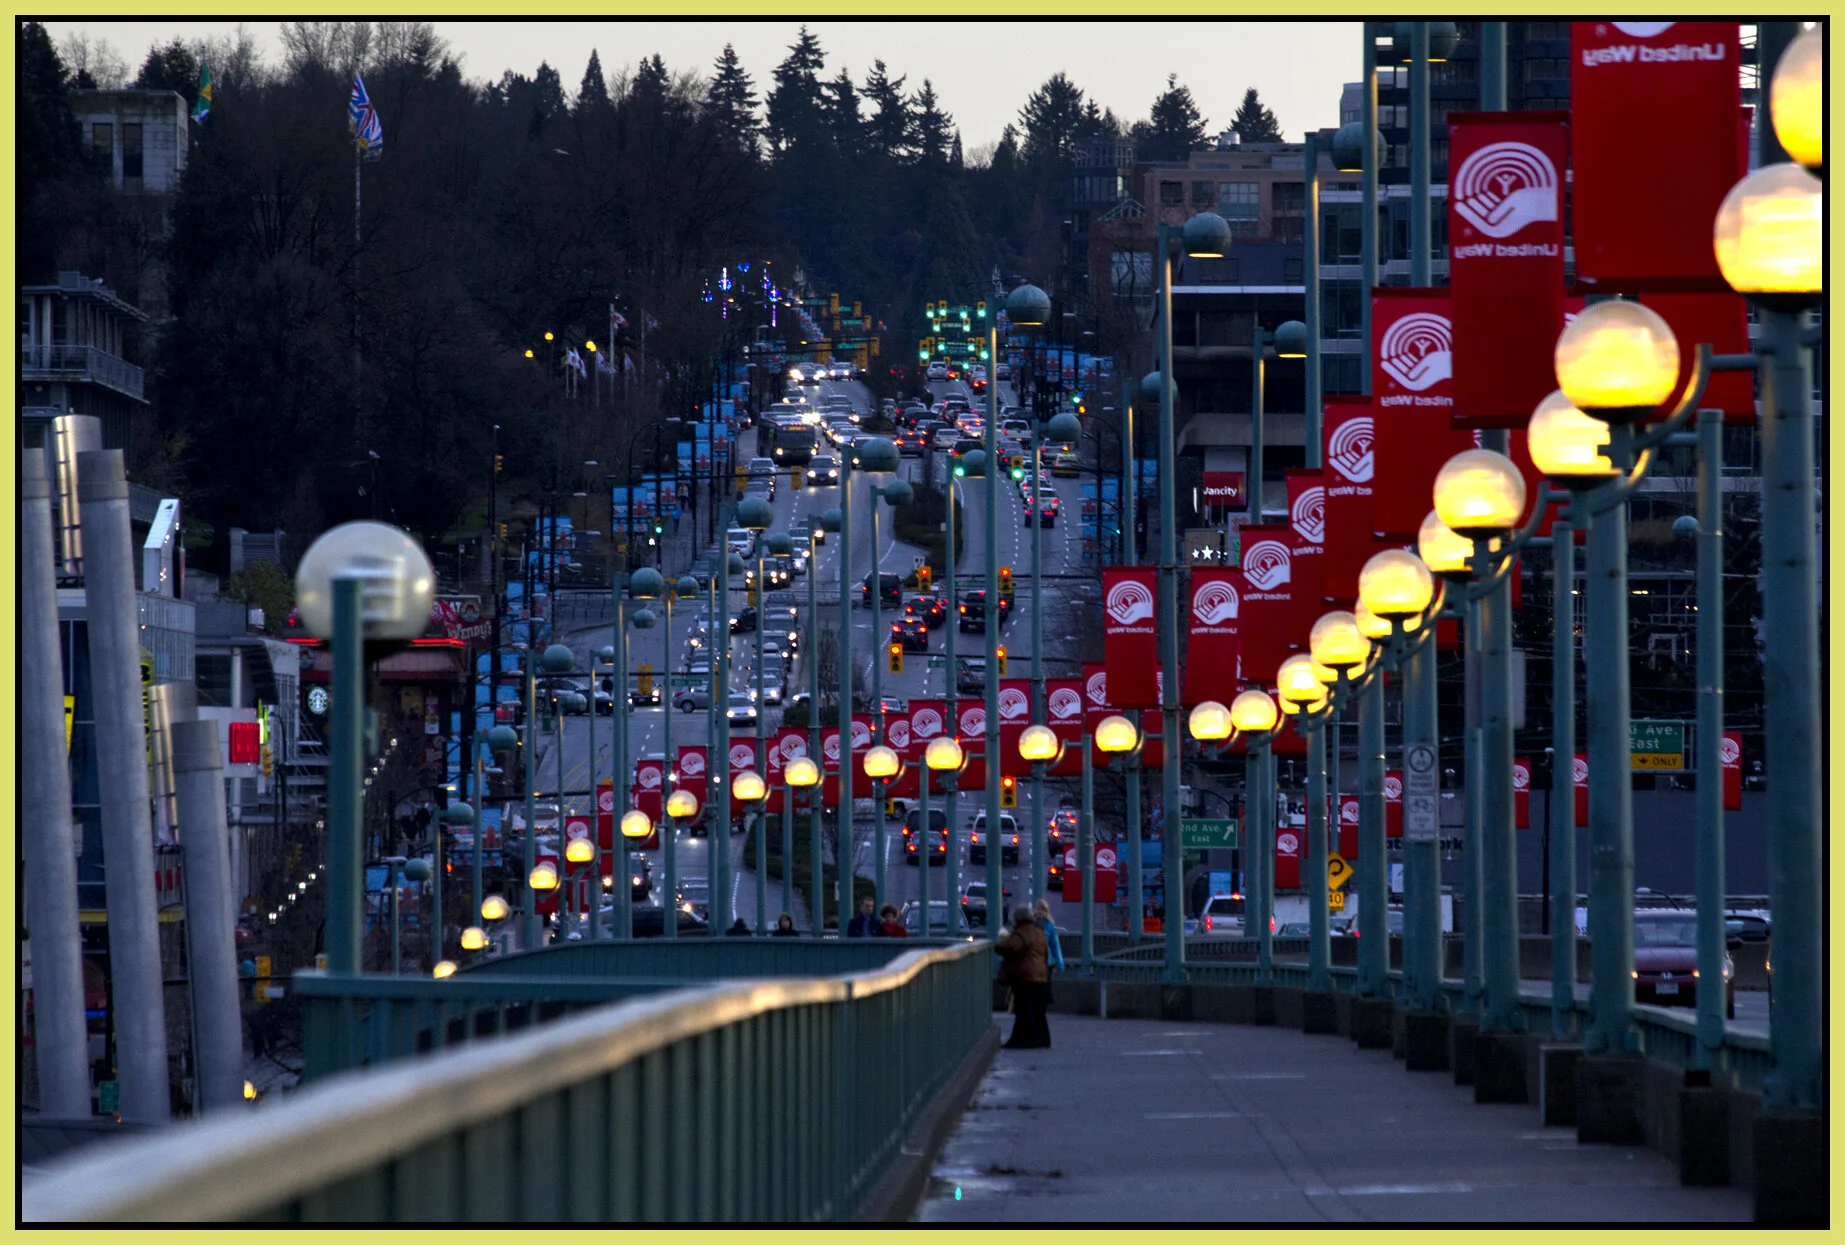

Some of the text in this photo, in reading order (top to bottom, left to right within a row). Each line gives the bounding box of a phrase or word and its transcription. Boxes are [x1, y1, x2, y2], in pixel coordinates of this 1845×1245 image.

[1646, 724, 1678, 736] Ave.
[1652, 757, 1677, 766] ONLY
[1191, 835, 1210, 843] East
